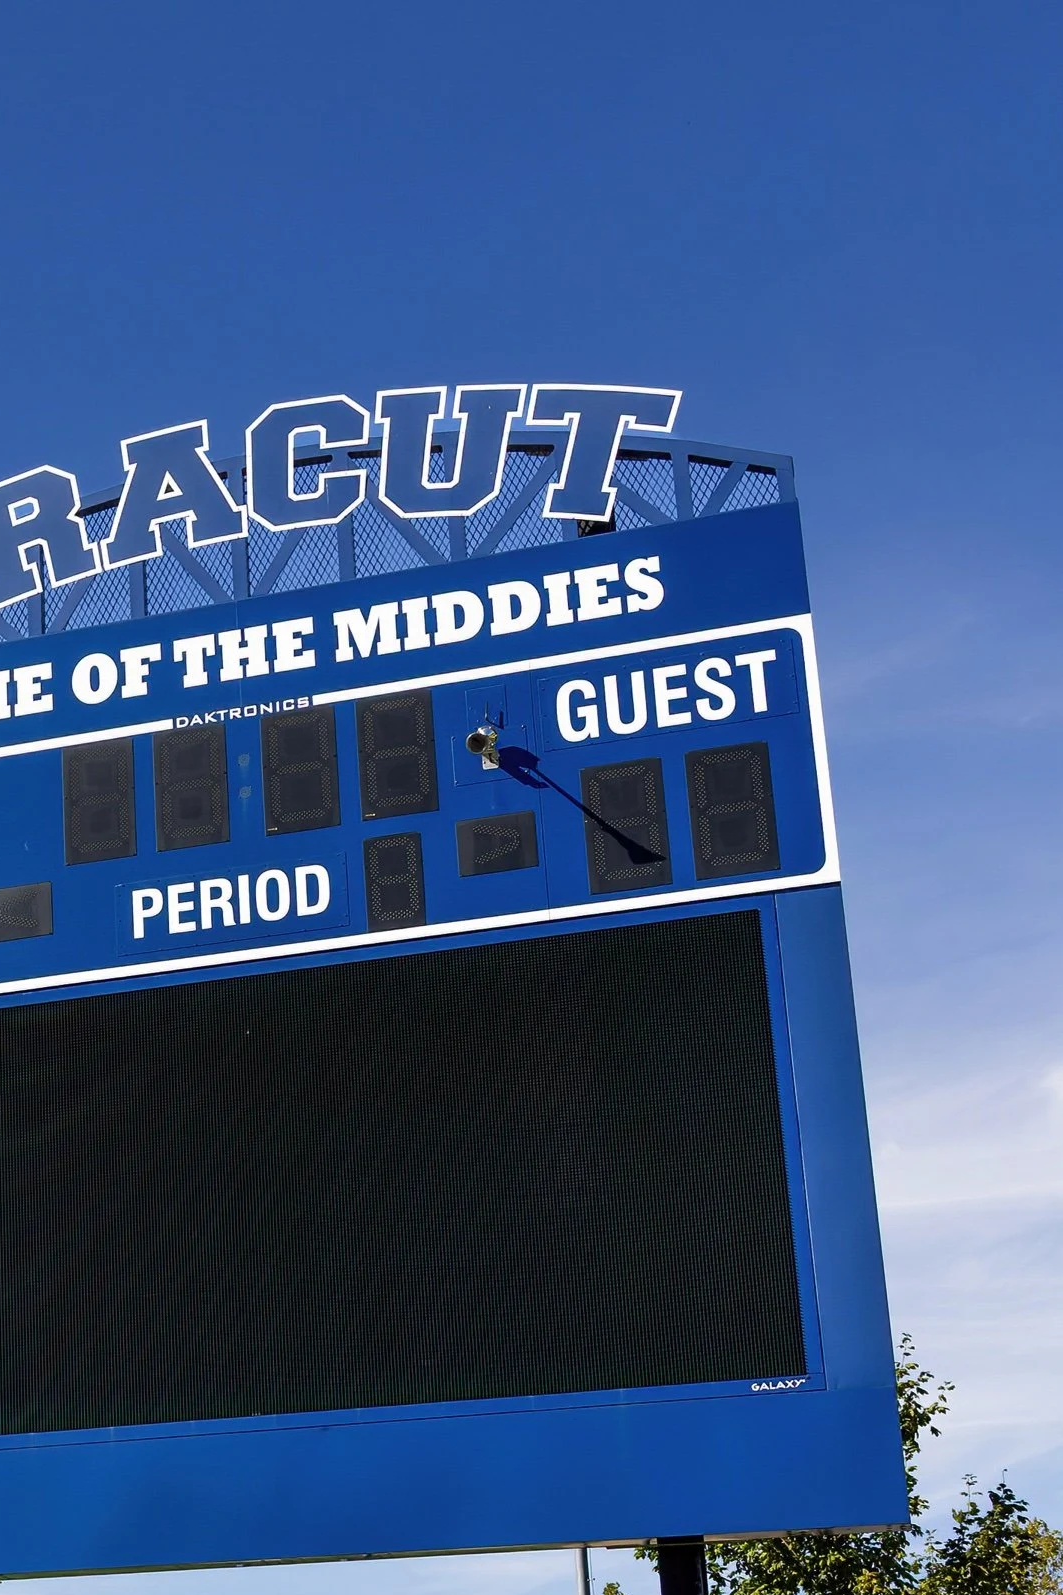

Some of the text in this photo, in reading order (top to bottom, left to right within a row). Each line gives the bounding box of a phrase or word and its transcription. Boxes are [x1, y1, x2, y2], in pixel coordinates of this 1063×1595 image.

[71, 643, 162, 705] OF
[172, 616, 316, 689] THE
[332, 555, 665, 663] MIDDIES
[175, 696, 310, 729] DAKTRONICS
[556, 649, 777, 743] GUEST
[131, 864, 330, 939] PERIOD
